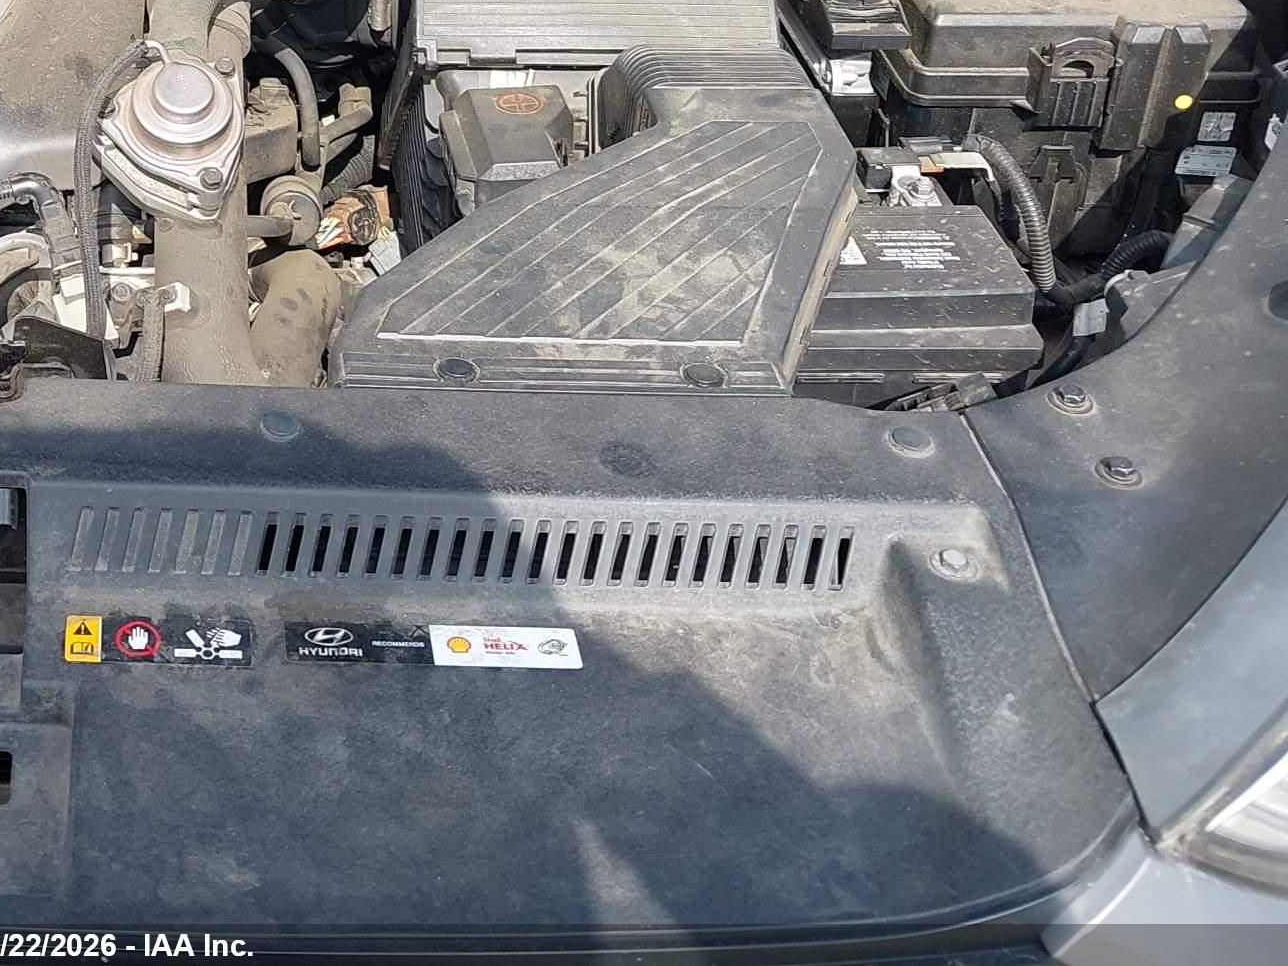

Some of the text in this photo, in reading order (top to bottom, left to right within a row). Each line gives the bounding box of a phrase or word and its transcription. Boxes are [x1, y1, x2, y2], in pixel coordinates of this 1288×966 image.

[298, 646, 364, 657] HYUNDAI
[372, 640, 425, 648] RECOMMENDS
[483, 641, 529, 650] HELIX
